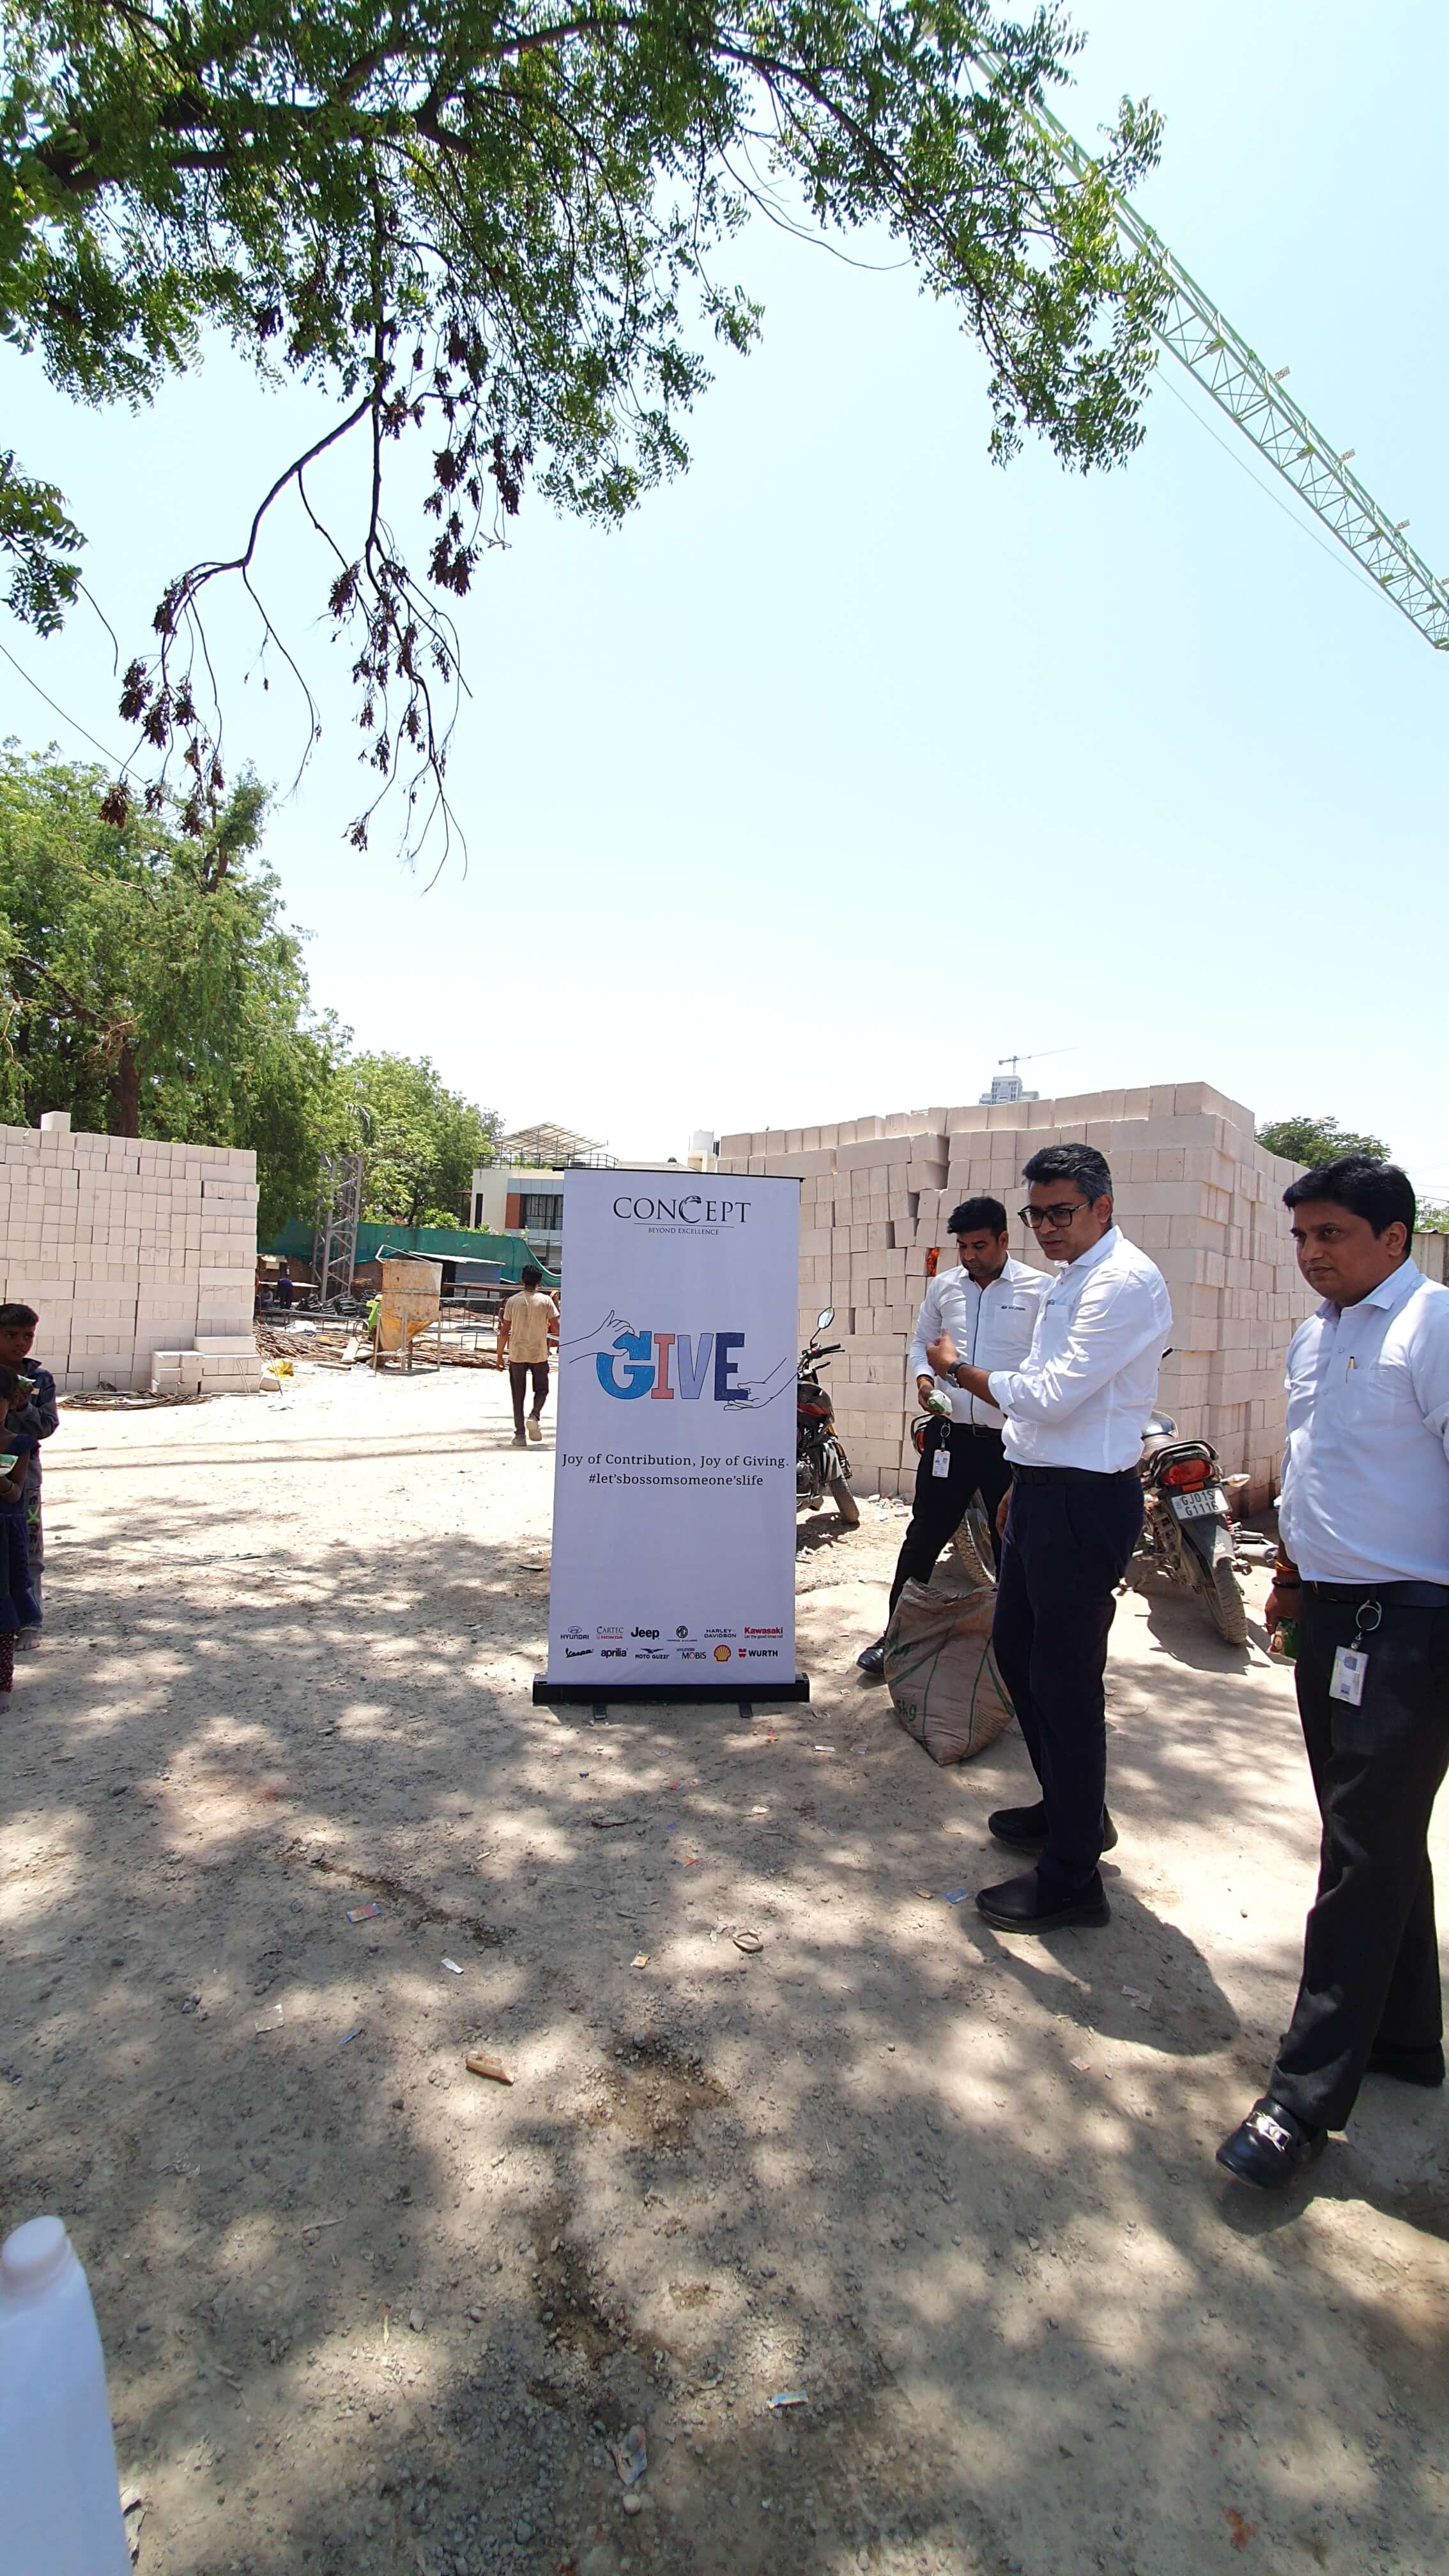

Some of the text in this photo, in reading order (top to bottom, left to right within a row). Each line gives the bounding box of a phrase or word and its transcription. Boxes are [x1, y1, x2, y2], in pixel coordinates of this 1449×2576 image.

[613, 1195, 751, 1223] CONCEPT
[596, 1331, 749, 1401] GIVE
[562, 1453, 789, 1469] Joy of Contribution, Joy of Giving.
[1181, 1490, 1215, 1506] GJ01S
[1185, 1501, 1219, 1516] G1116
[631, 1627, 659, 1639] Jeep
[601, 1648, 627, 1659] aprilia
